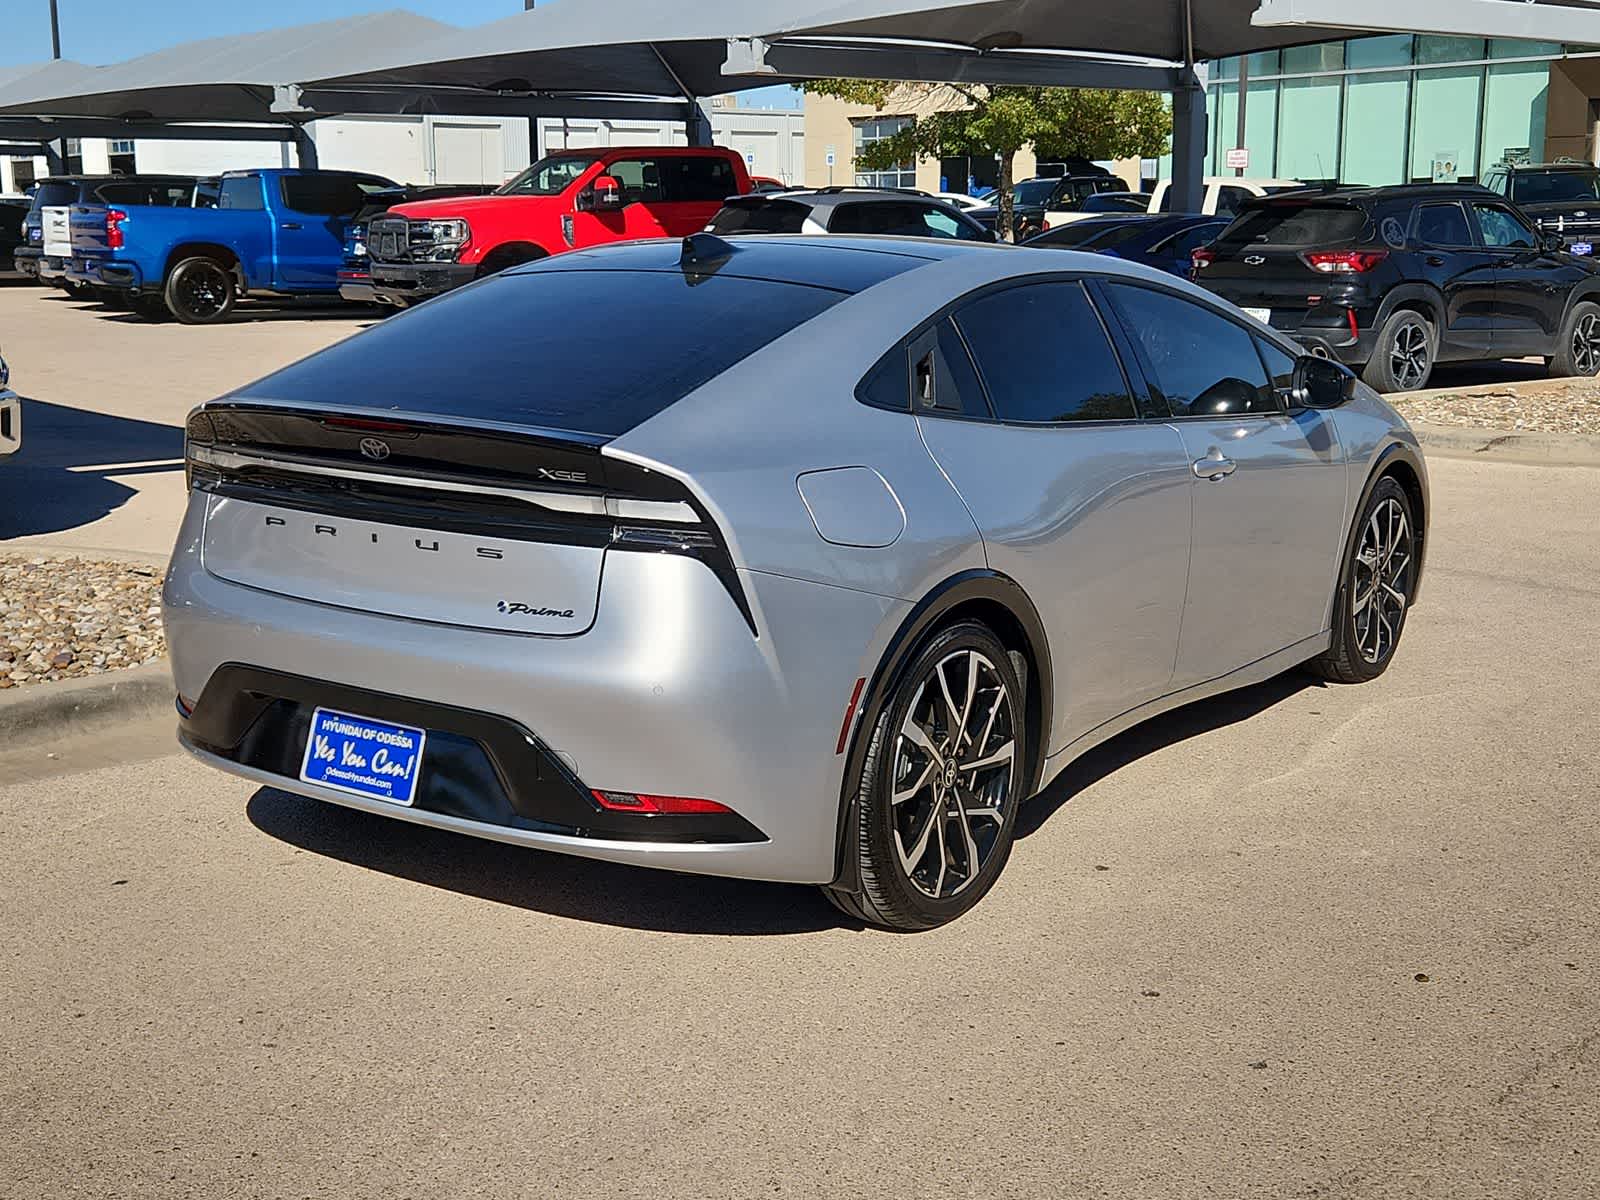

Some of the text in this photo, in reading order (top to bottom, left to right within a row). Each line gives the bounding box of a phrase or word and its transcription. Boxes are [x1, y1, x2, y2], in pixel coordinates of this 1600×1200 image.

[538, 468, 587, 483] XSE
[265, 516, 503, 559] PRIUS
[508, 602, 575, 618] Prime
[322, 720, 413, 749] HYUNDAI OF ODESSA
[314, 735, 415, 780] Yes You Can!
